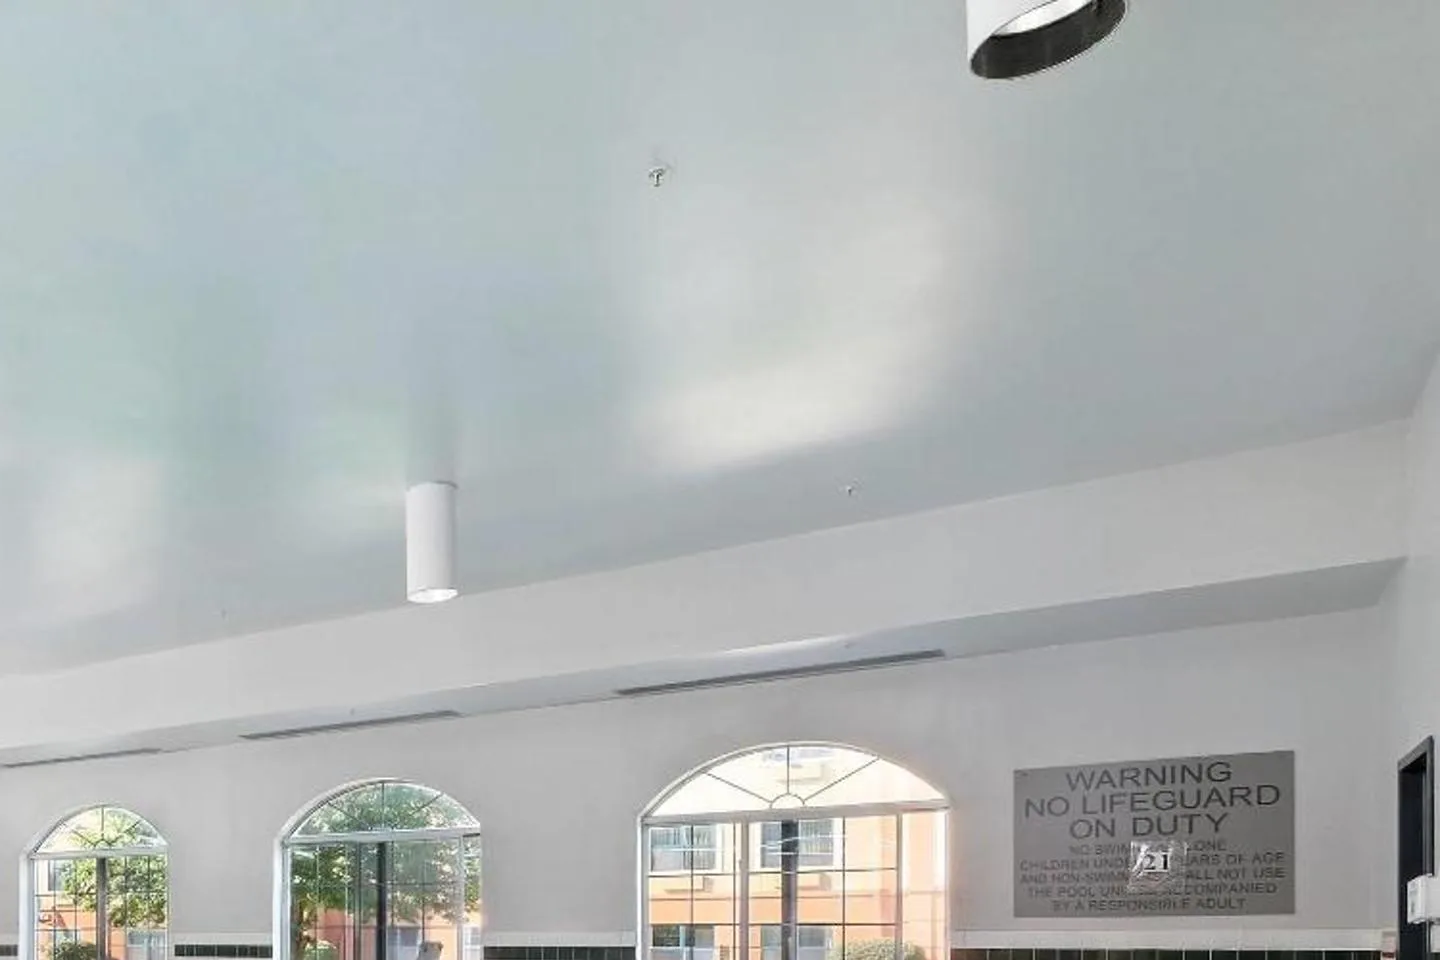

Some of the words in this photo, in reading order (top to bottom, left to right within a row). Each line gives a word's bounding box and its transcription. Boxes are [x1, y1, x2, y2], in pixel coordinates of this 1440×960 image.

[1065, 760, 1233, 792] WARNING
[1023, 795, 1070, 818] NO
[1082, 784, 1281, 815] LIFEGUARD
[1069, 818, 1116, 840] ON
[1132, 812, 1229, 838] DUTY
[1093, 855, 1135, 869] UNDE
[1143, 853, 1169, 871] 21
[1252, 851, 1285, 864] AGE
[1217, 867, 1246, 880] NOT
[1253, 866, 1286, 879] USE
[1196, 897, 1247, 910] ADULT
